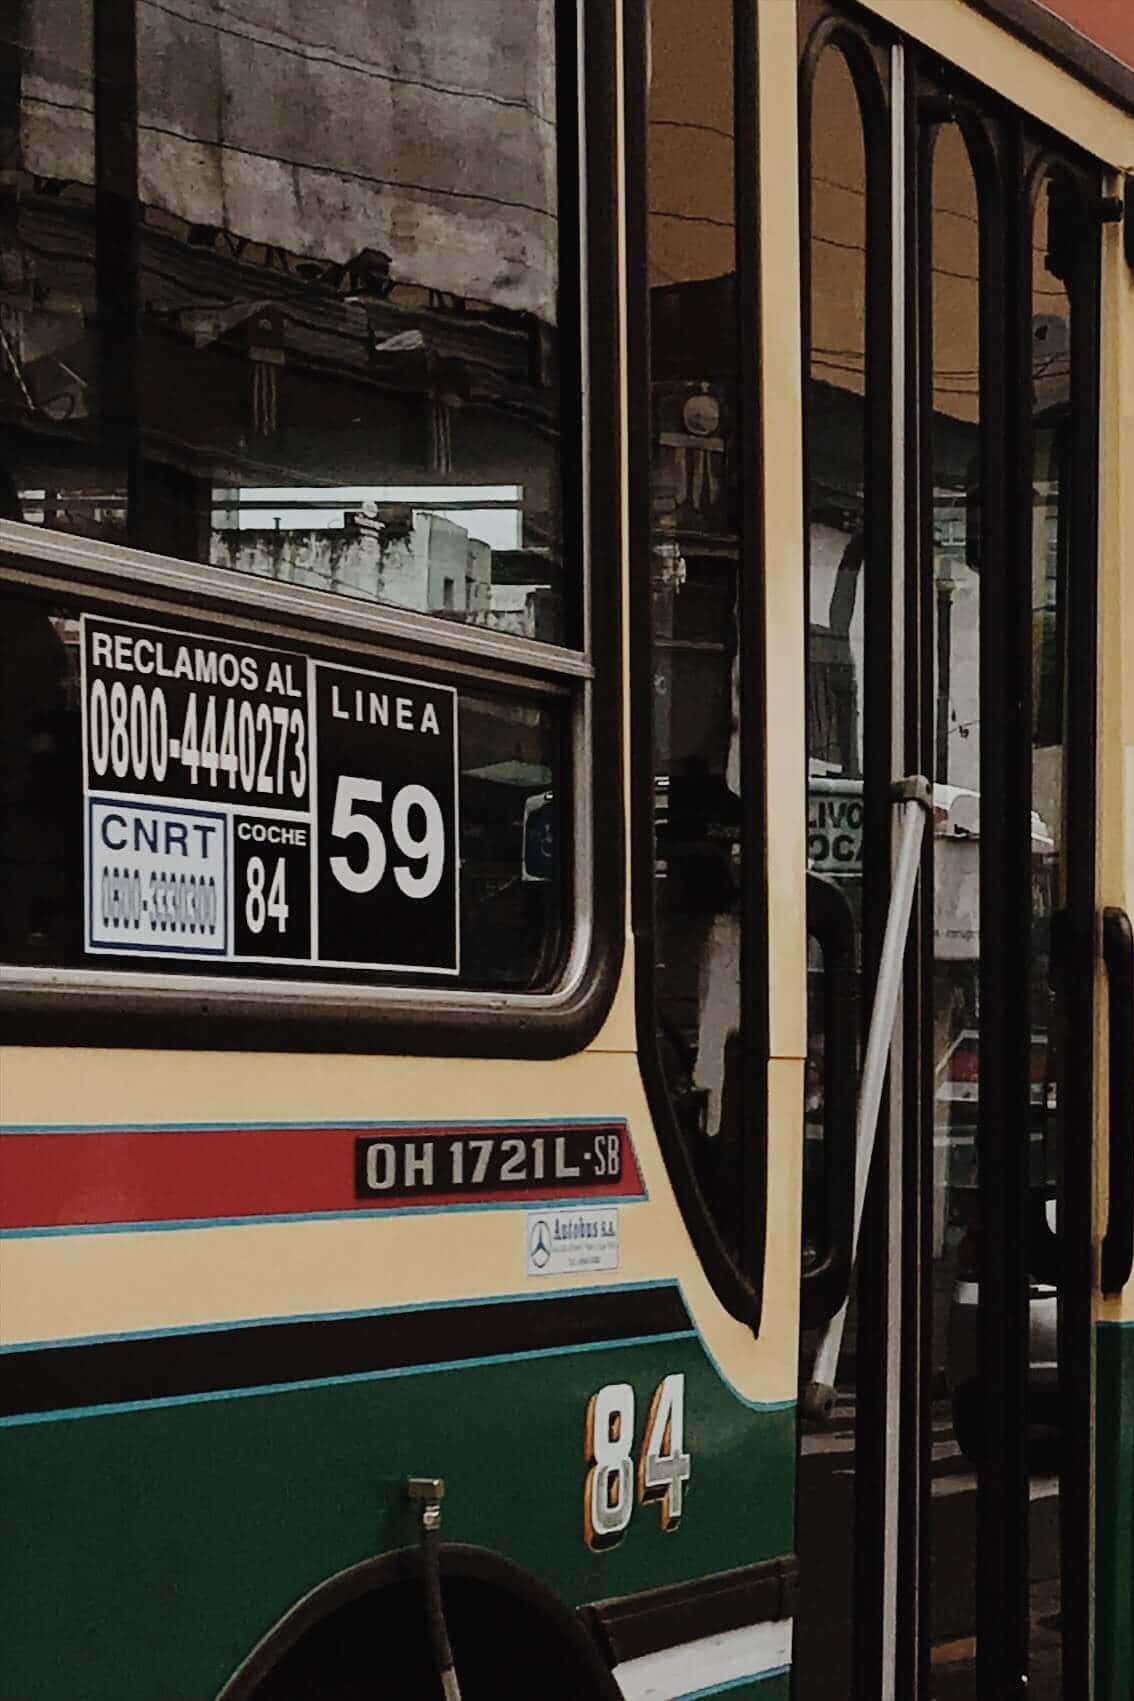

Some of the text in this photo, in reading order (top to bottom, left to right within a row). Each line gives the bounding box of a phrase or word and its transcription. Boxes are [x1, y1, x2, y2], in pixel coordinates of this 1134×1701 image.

[91, 631, 302, 697] RECLAMOS AL
[90, 678, 306, 799] 0800-4440273
[331, 685, 441, 736] LINEA
[101, 813, 217, 859] CNRT
[237, 822, 307, 847] COCHE
[329, 775, 446, 900] 59
[245, 856, 290, 935] 84
[366, 1142, 434, 1191] OH
[583, 1372, 691, 1553] 84
